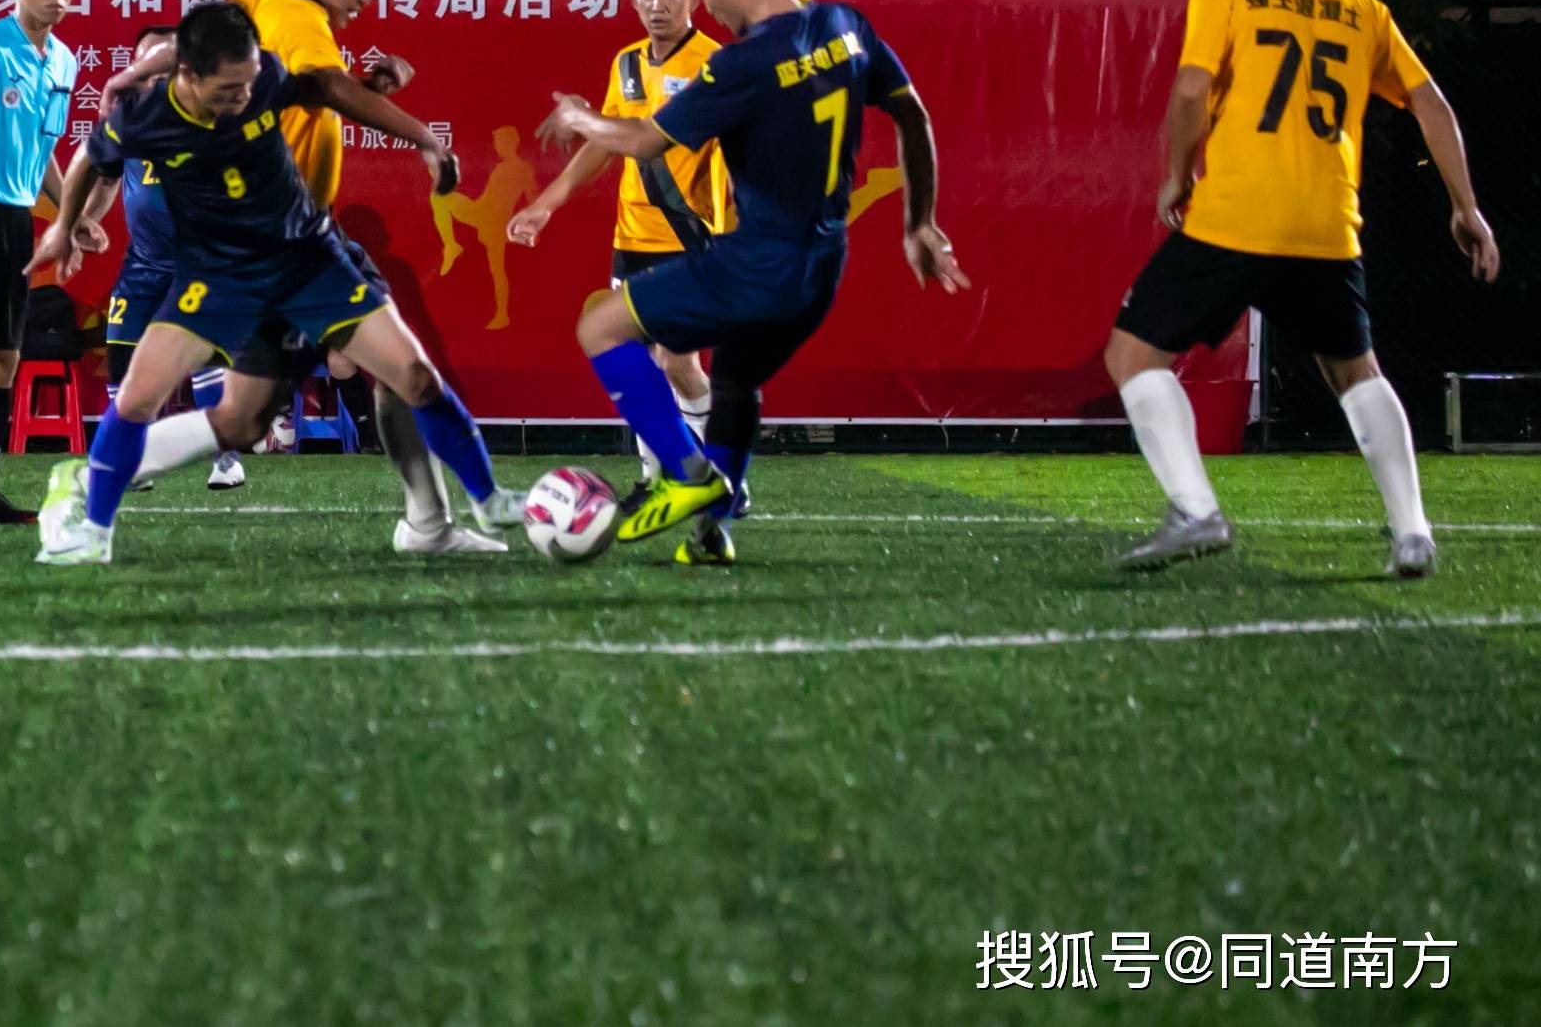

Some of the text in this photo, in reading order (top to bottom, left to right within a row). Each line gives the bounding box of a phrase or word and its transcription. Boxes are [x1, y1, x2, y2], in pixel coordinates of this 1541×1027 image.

[1256, 28, 1349, 144] 75
[813, 88, 848, 196] 7
[224, 168, 247, 199] 8
[178, 281, 208, 313] 8
